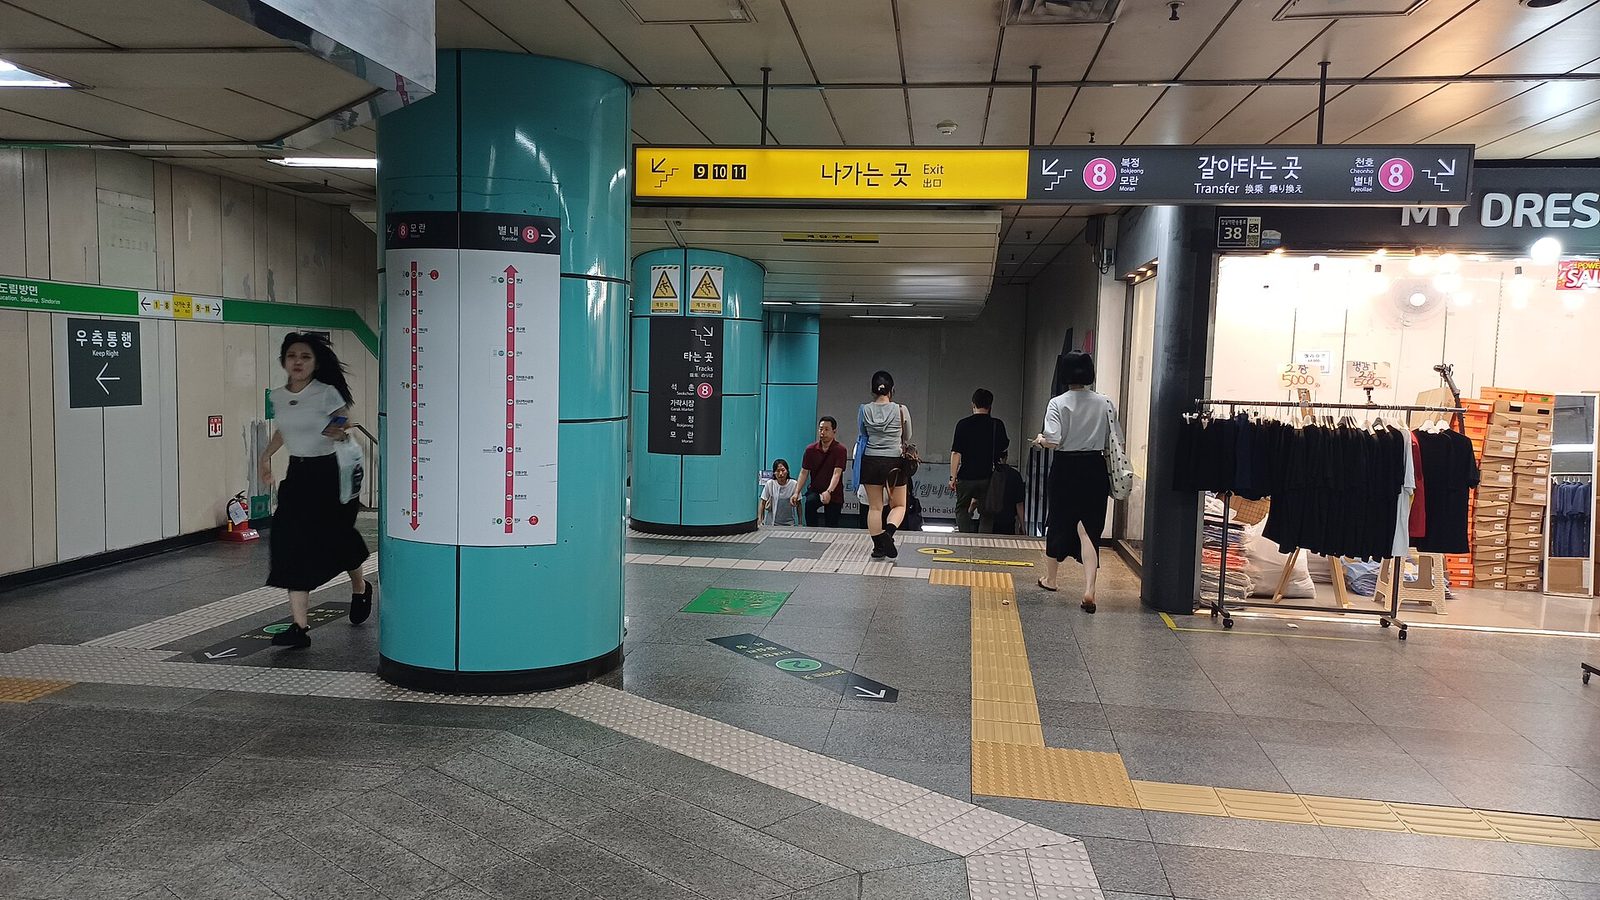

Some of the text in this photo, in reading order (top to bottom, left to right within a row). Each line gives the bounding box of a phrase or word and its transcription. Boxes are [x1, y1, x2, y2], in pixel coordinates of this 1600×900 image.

[1120, 158, 1140, 168] 복정
[1197, 155, 1303, 180] 갈아타는 곳
[1354, 157, 1375, 168] 천호
[697, 166, 744, 178] 9 10 11
[821, 162, 911, 186] 나가는 곳
[923, 164, 944, 175] Exit
[923, 178, 942, 188] 出口
[1119, 176, 1139, 186] 모란
[1353, 176, 1373, 187] 별내
[1193, 182, 1240, 194] Transfer
[498, 225, 519, 236] 별내
[1223, 227, 1242, 240] 38
[75, 329, 132, 348] 우측통행
[92, 349, 119, 358] Keep Right
[683, 351, 714, 362] 타는 곳
[1282, 373, 1315, 387] 5000
[1353, 378, 1382, 387] 5000
[670, 399, 695, 407] 가락시장
[928, 506, 941, 514] the
